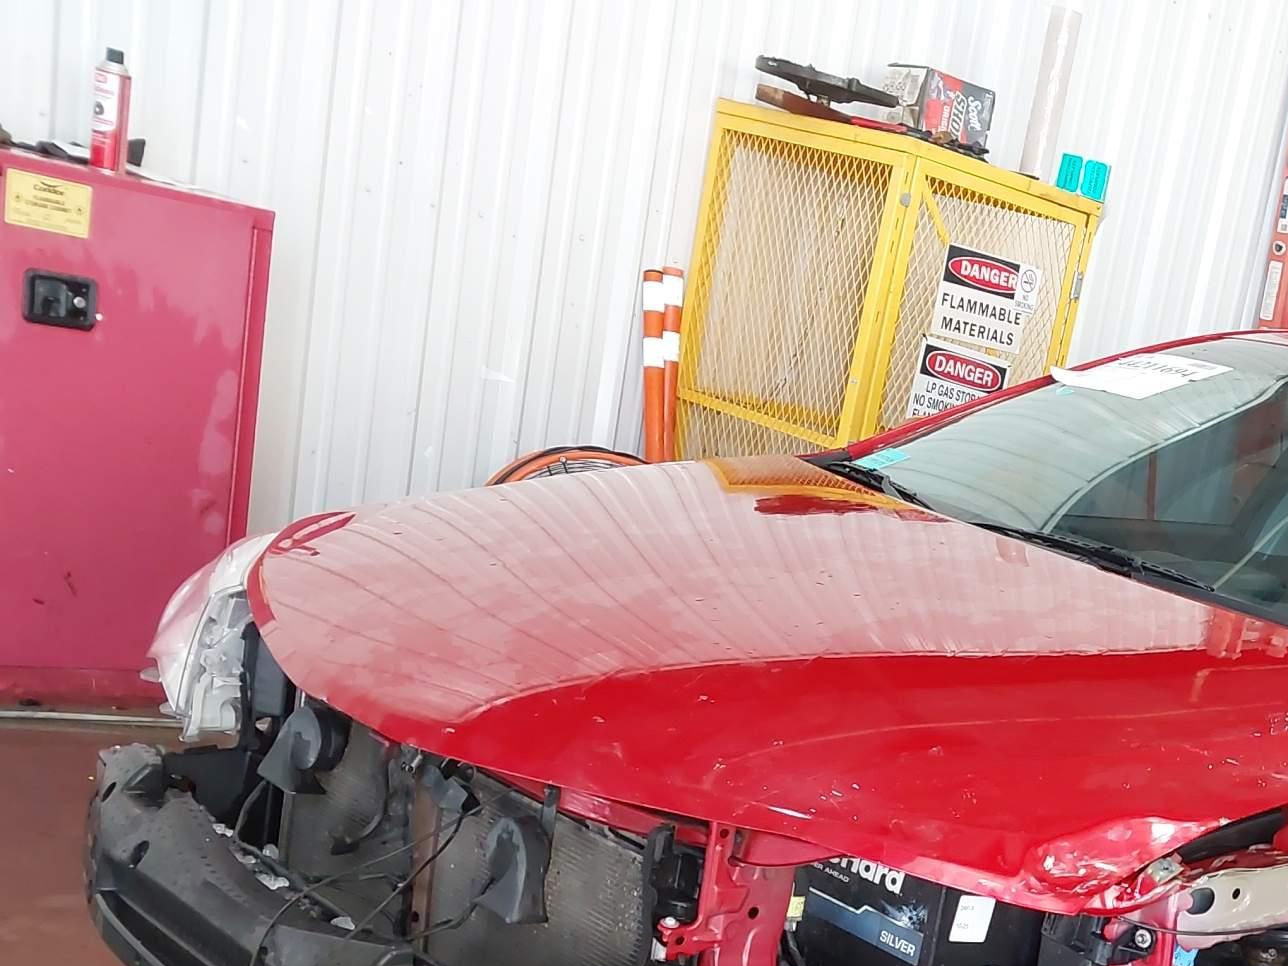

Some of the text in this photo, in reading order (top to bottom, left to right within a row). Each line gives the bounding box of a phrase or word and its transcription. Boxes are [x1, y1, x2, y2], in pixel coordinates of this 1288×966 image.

[967, 96, 982, 131] Scott
[960, 259, 1018, 289] DANGER
[941, 292, 1022, 326] FLAMMABLE
[940, 316, 1014, 346] MATERIALS
[934, 355, 994, 387] DANGER
[912, 393, 926, 406] NO
[925, 381, 936, 393] LP
[937, 384, 955, 400] GAS
[824, 866, 850, 882] AHEAD
[879, 930, 916, 957] SILVER
